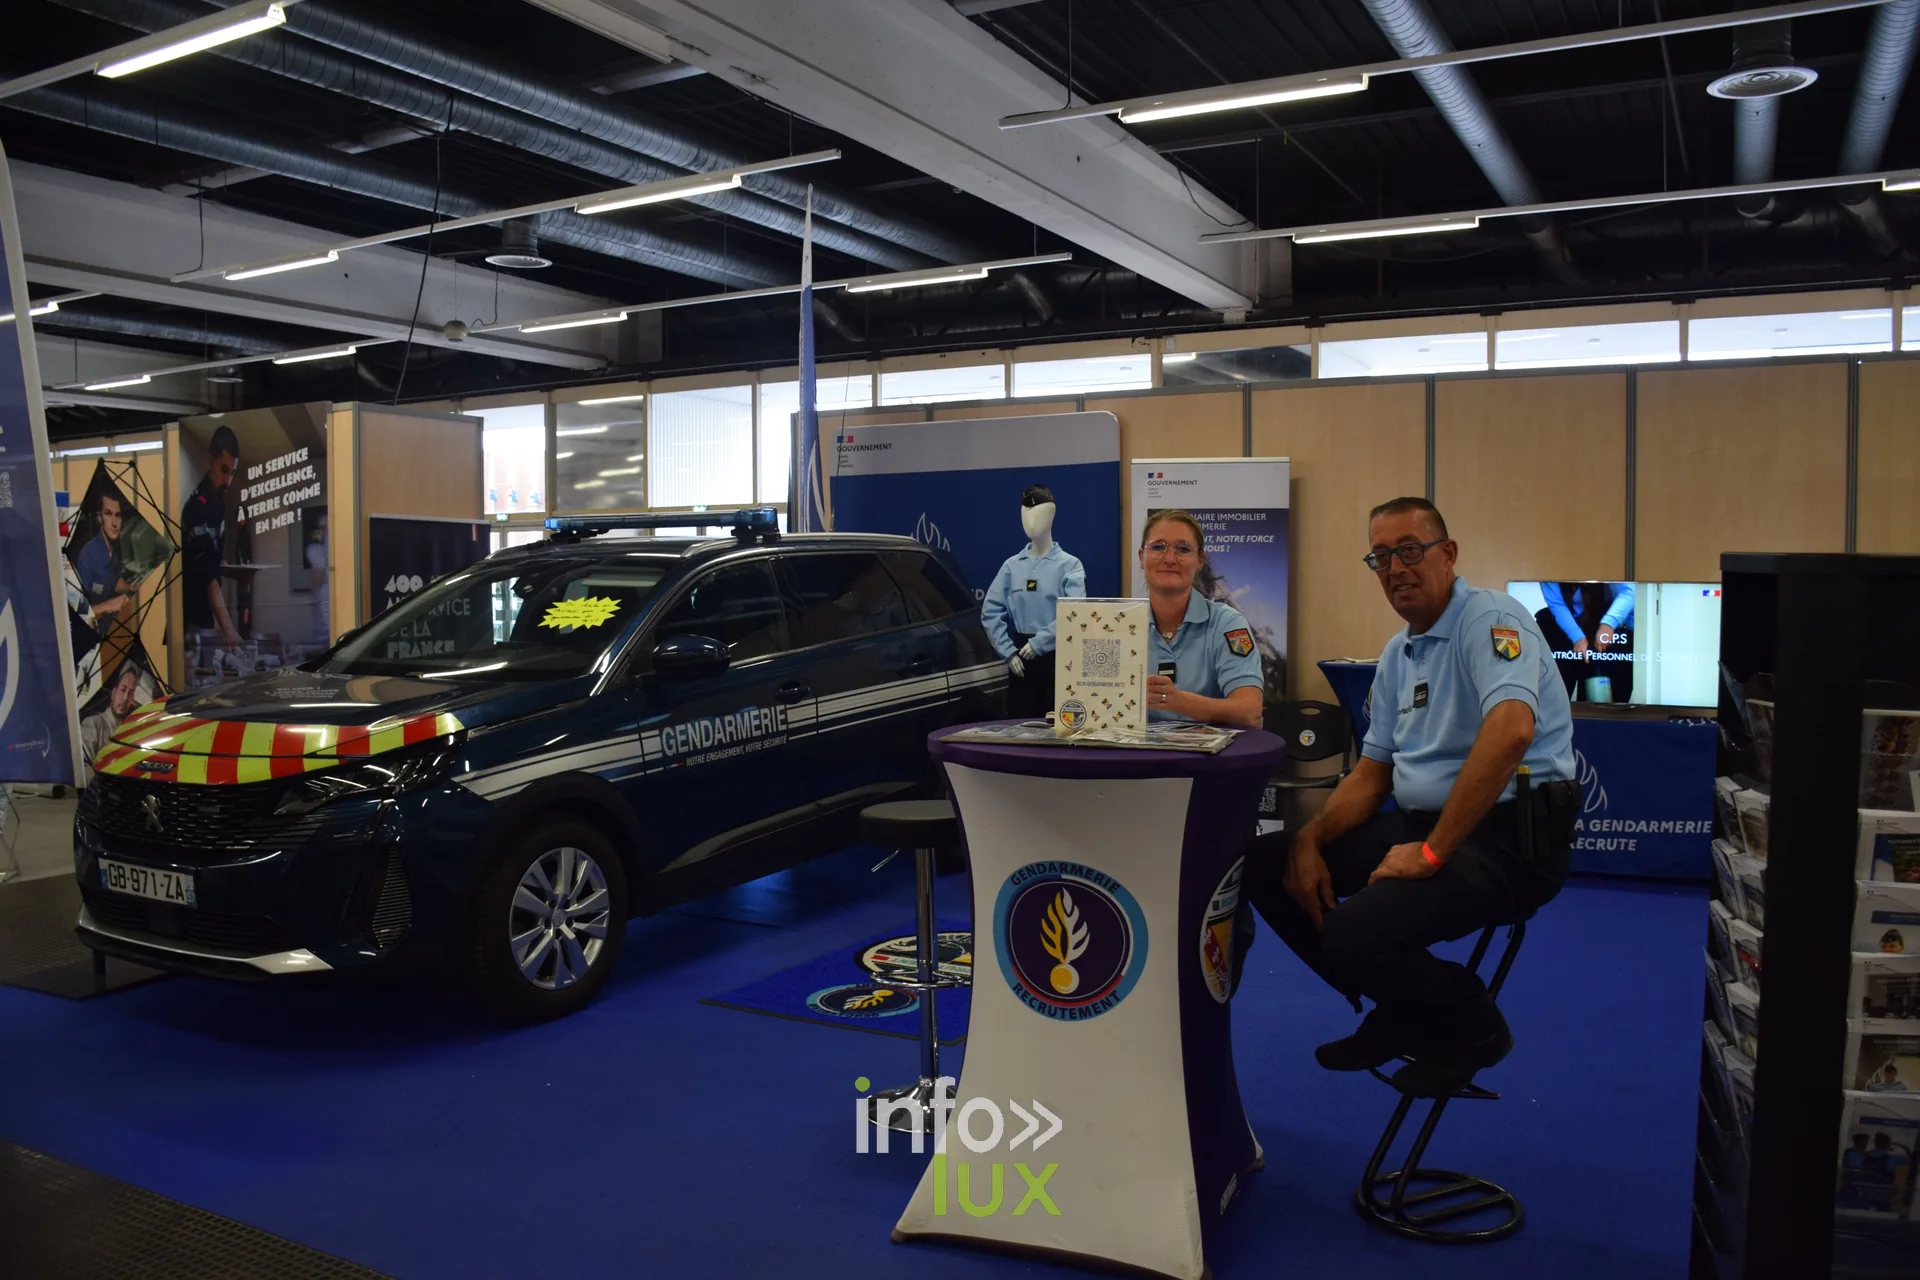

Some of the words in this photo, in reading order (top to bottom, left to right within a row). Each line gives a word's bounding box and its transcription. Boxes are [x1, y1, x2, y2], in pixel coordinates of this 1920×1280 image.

[836, 443, 893, 453] GOUVERNEMENT
[247, 463, 263, 480] UN
[265, 446, 308, 475] SERVICE
[240, 464, 316, 502] D'EXCELLENCE,
[247, 495, 281, 519] TERRE
[282, 481, 321, 506] COMME
[255, 518, 269, 535] EN
[271, 510, 295, 530] MER
[1217, 513, 1267, 521] IMMOBILIER
[1216, 535, 1246, 543] NOTRE
[1246, 535, 1275, 543] FORCE
[384, 574, 424, 594] 400
[387, 640, 456, 660] FRANCE
[1599, 633, 1628, 645] C.P.S
[1551, 650, 1583, 660] NTRÔLE
[662, 703, 788, 757] GENDARMERIE
[686, 754, 706, 767] NOTRE
[706, 745, 745, 763] ENGAGEMENT,
[745, 741, 762, 753] VOTRE
[762, 734, 788, 749] SÉCURITÉ
[1574, 818, 1585, 831] A
[1588, 818, 1713, 834] GENDARMERIE
[108, 863, 185, 901] GB-971-ZA
[1011, 861, 1121, 895] GENDARMERIE
[1013, 982, 1122, 1021] RECRUTEMENT
